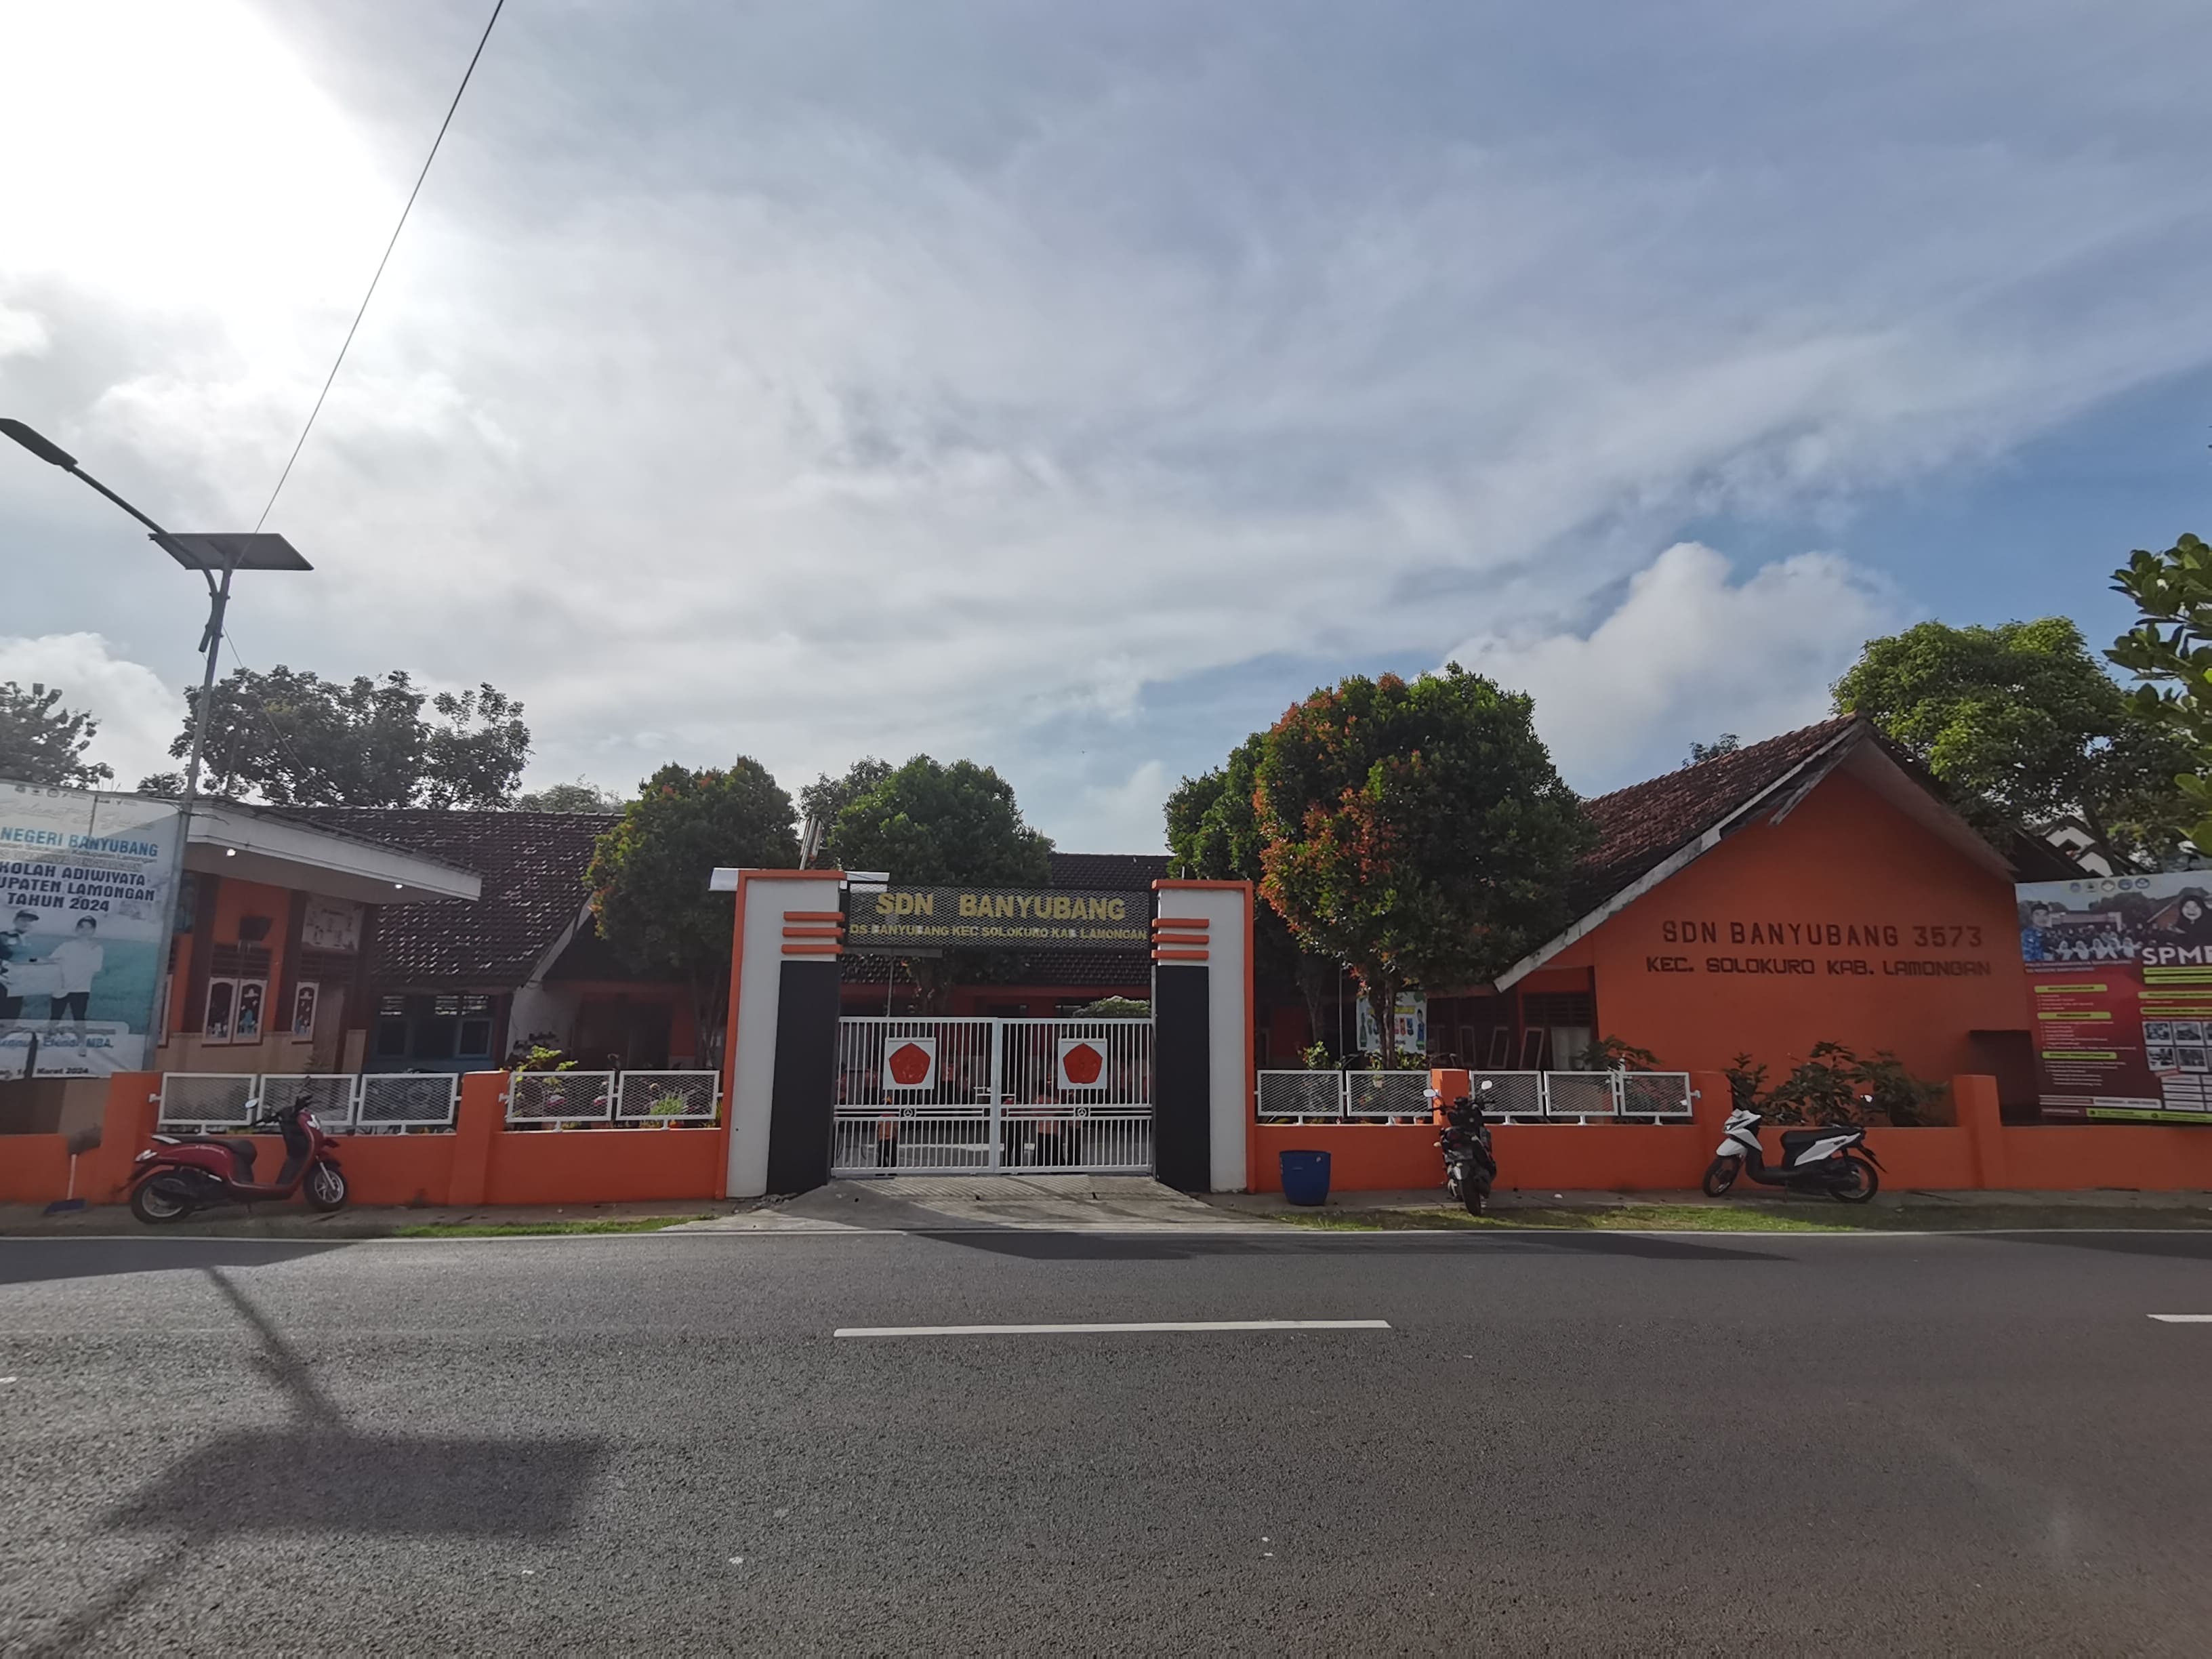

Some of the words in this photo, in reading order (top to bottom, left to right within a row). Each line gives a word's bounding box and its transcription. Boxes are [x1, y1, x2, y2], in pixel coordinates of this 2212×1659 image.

[1, 826, 63, 846] NEGERI
[69, 834, 159, 857] BANYUBANG
[62, 867, 145, 886] ADIWIYATA
[67, 882, 155, 901] LAMONGAN
[7, 893, 64, 909] TAHUN
[69, 897, 110, 912] 2024
[876, 893, 934, 916] SDN
[960, 894, 1126, 921] BANYUBANG
[849, 924, 868, 935] DS
[871, 924, 949, 936] BANYUBANG
[951, 926, 980, 937] KEC
[982, 926, 1048, 938] SOLOKURO
[1052, 928, 1077, 939] KAB
[1080, 928, 1147, 940] LAMONGAN
[1662, 920, 1717, 943] SDN
[1730, 922, 1898, 947] BANYUBANG
[1912, 926, 1982, 947] 3573
[1646, 956, 1694, 972] KEC.
[1706, 958, 1816, 975] SOLOKURO
[1827, 960, 1875, 976] KAB.
[1883, 960, 1992, 976] LAMONGAN
